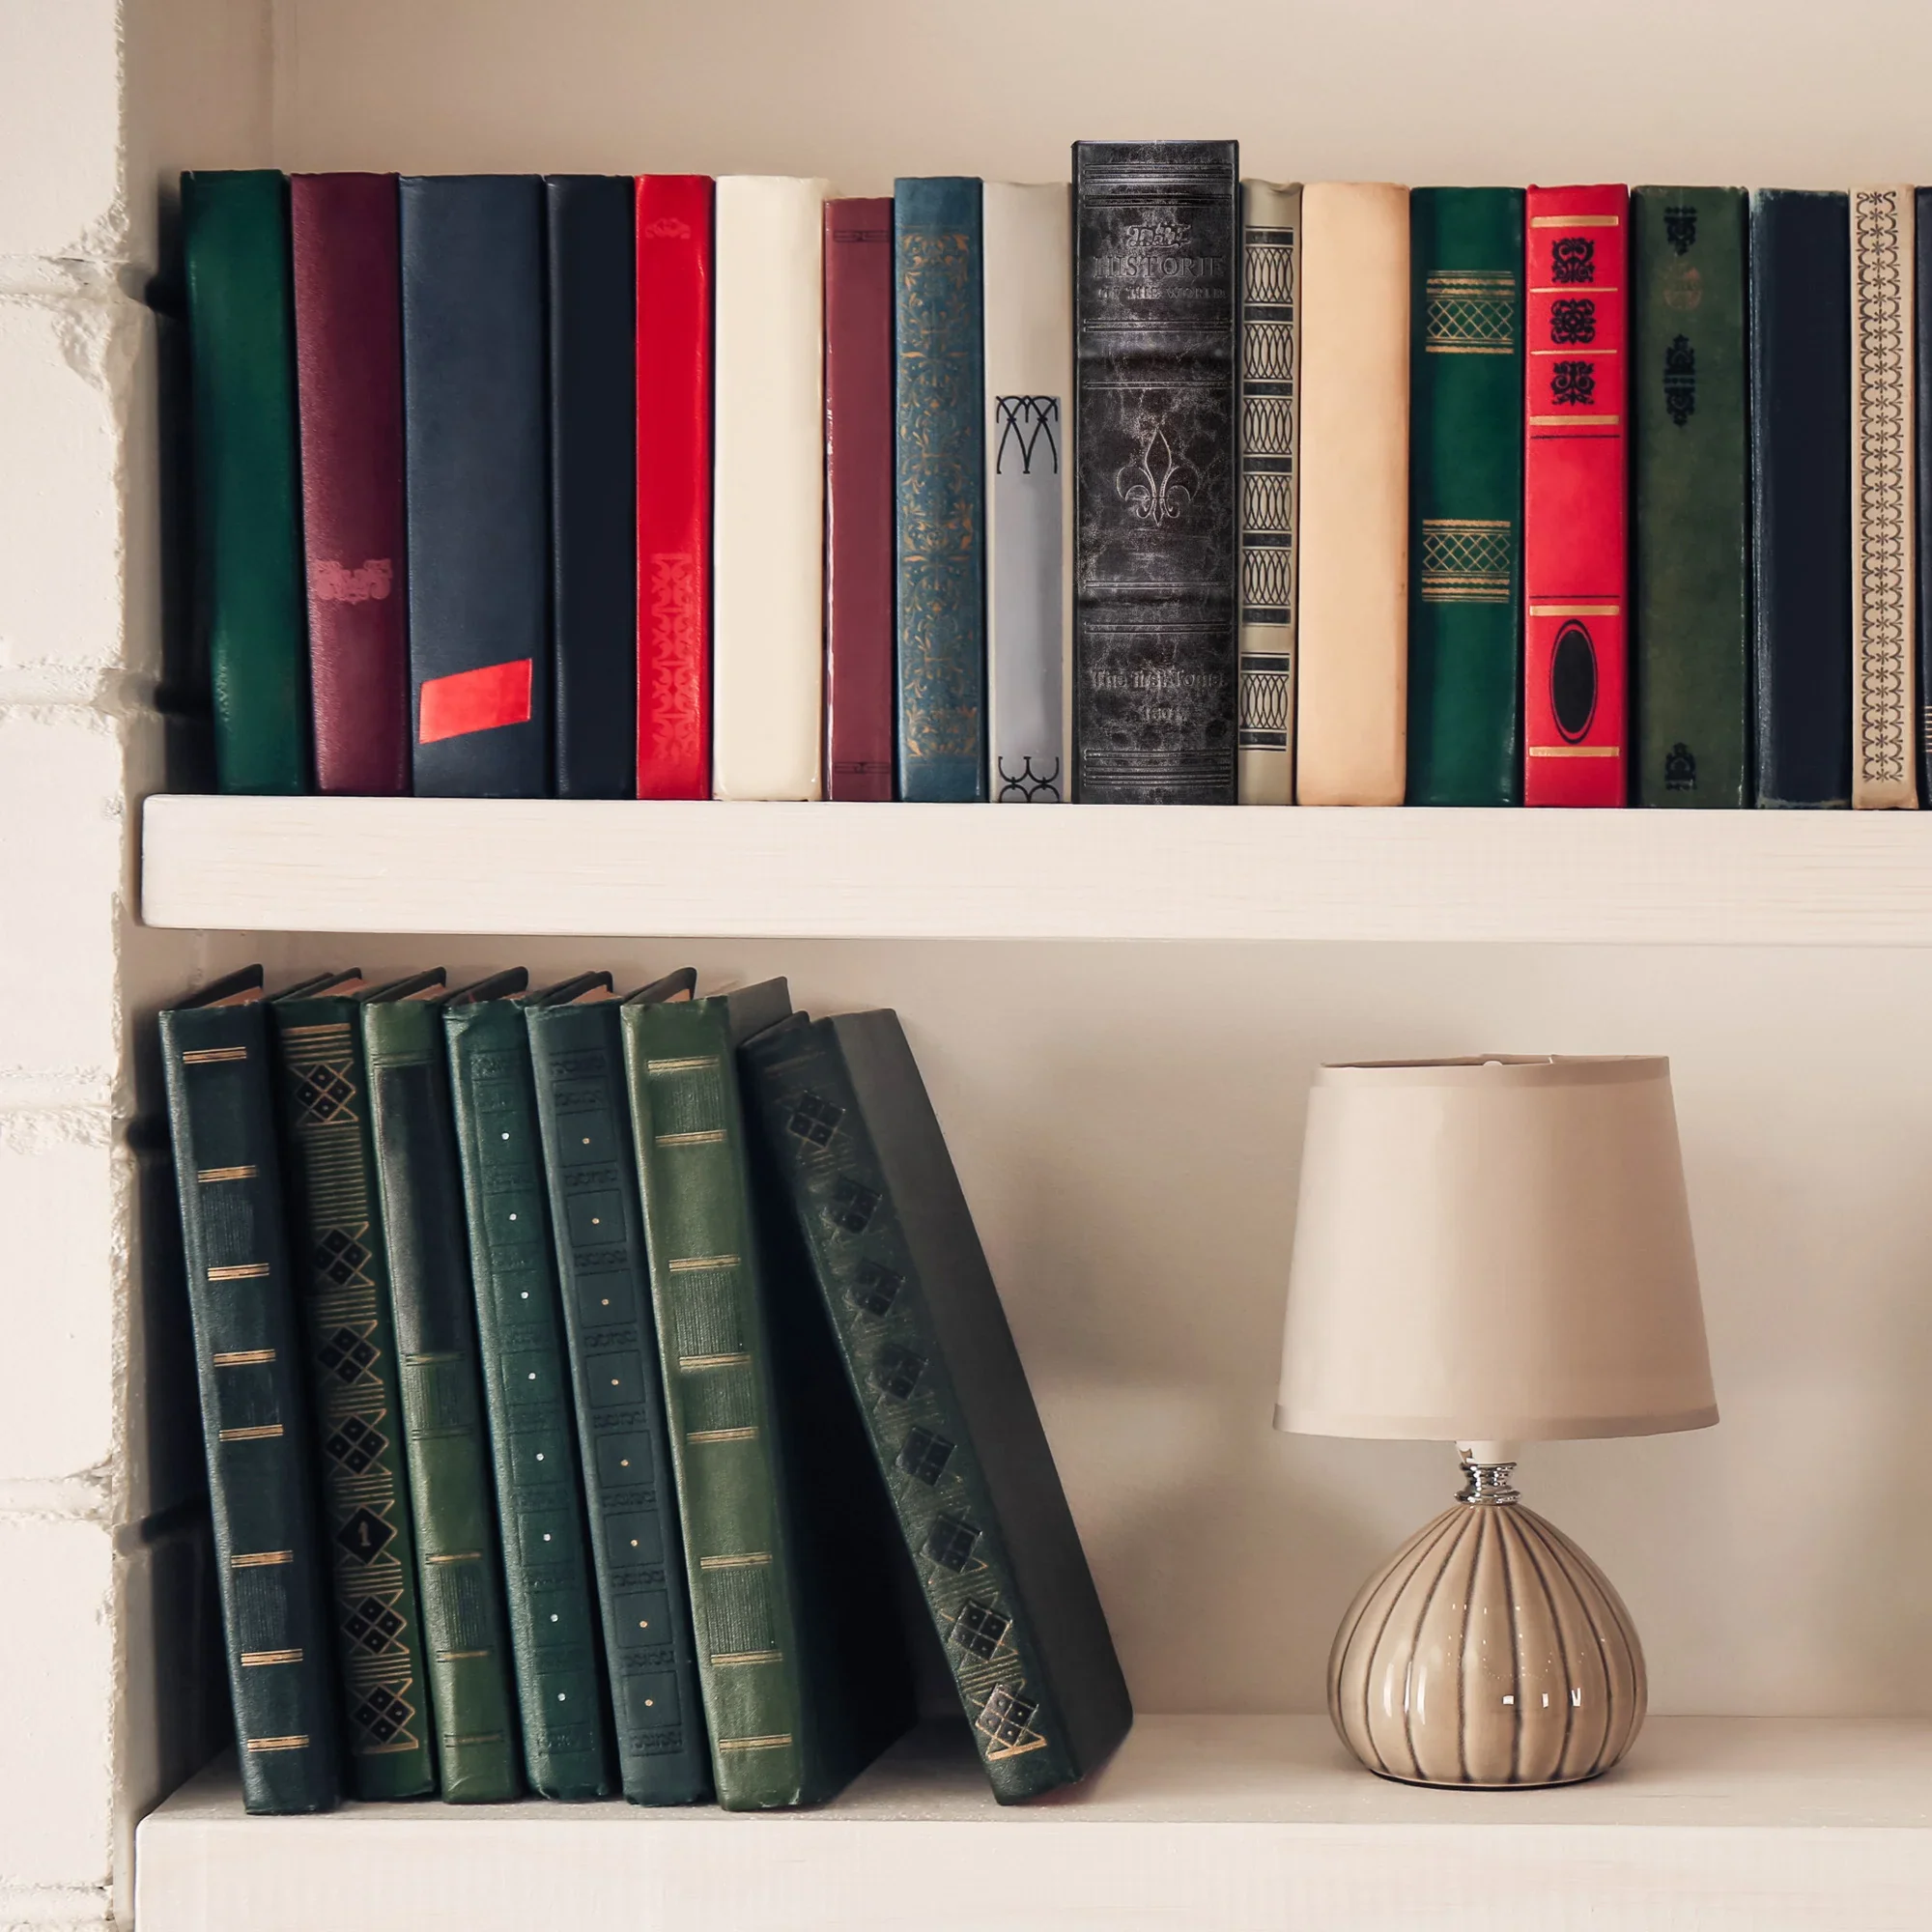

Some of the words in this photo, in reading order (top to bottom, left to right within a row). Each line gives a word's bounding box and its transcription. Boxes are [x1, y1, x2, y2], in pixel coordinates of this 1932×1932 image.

[1093, 255, 1224, 278] HISTORIE
[1125, 287, 1162, 299] THE
[357, 1520, 372, 1547] 1
